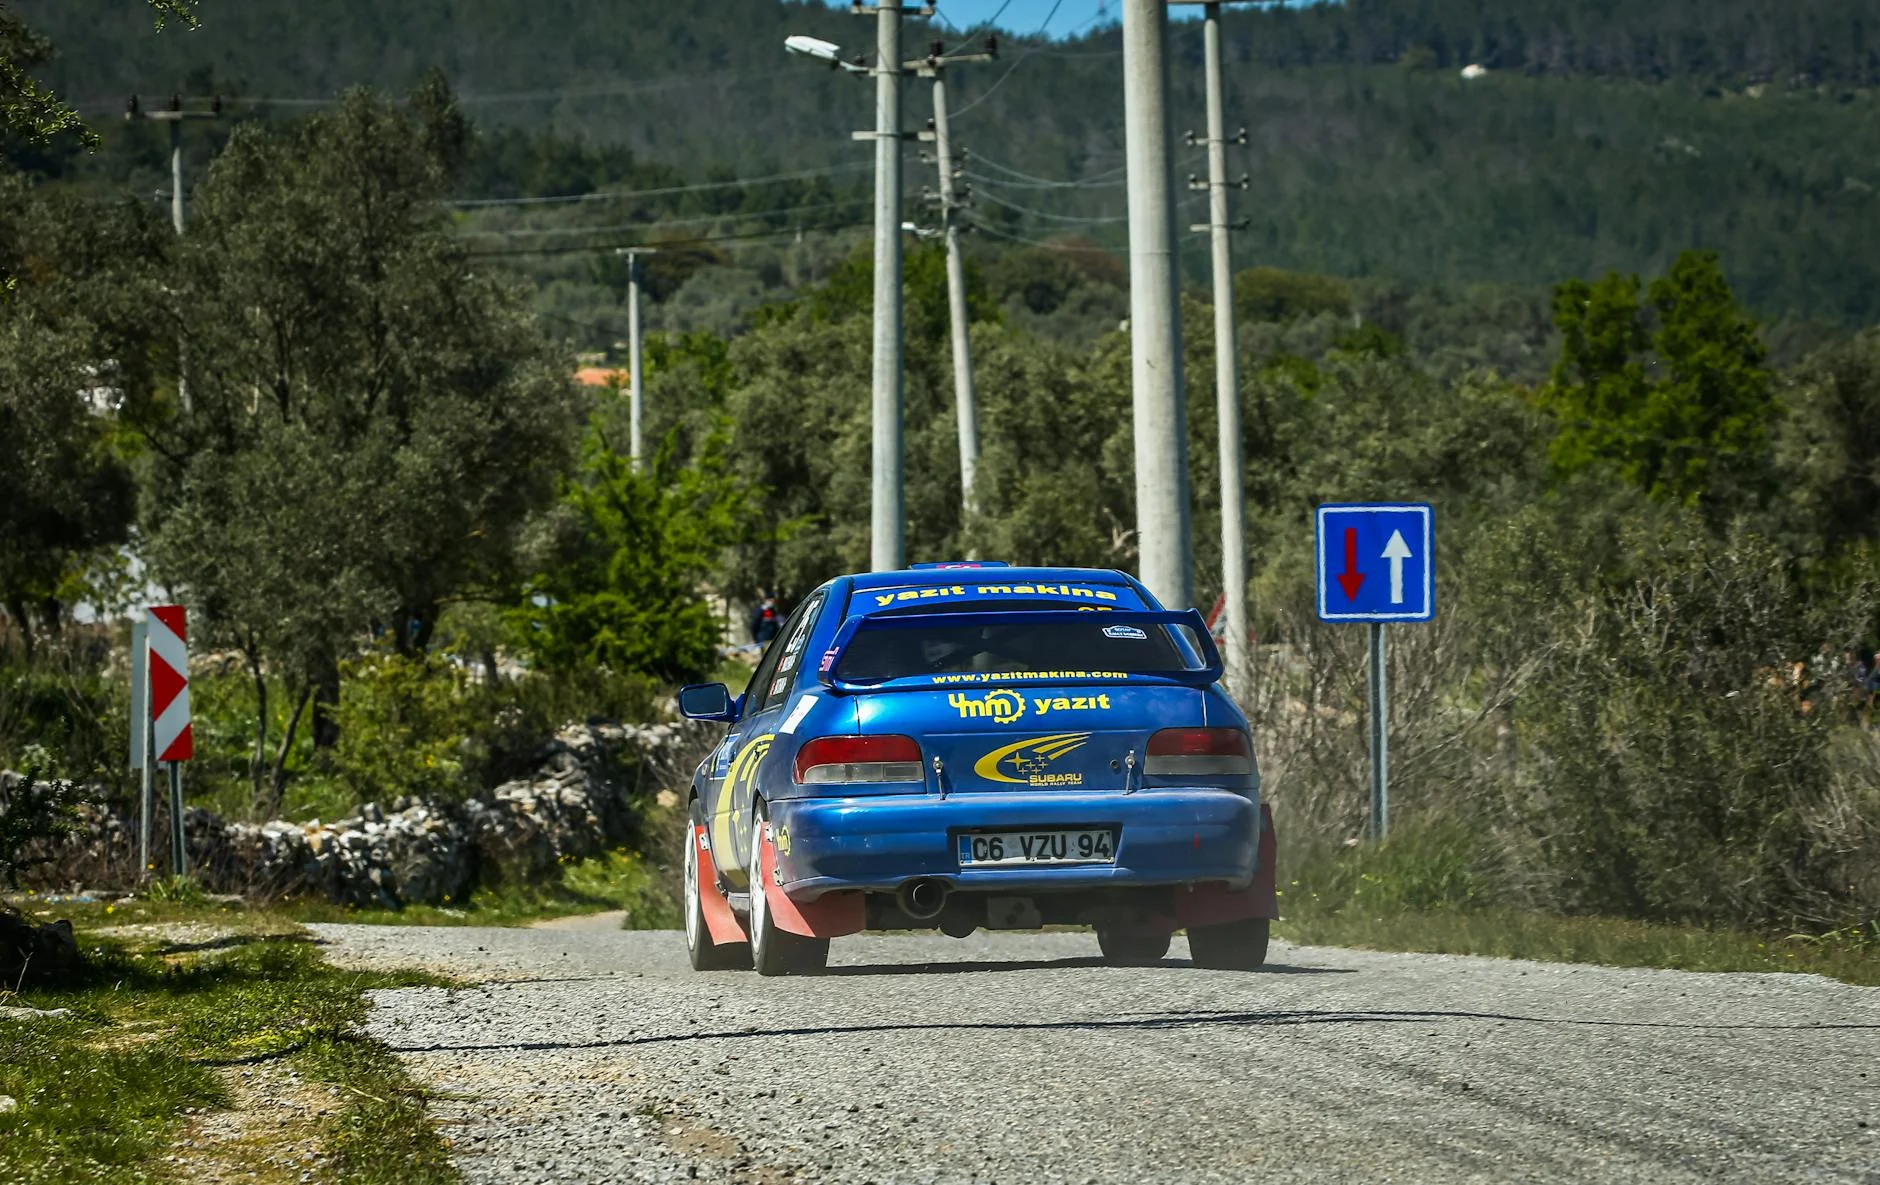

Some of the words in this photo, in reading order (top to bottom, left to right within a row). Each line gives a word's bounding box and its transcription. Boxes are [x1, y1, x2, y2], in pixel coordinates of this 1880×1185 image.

[932, 671, 1128, 684] www.yazitmakina.com
[1029, 773, 1082, 783] SUBARU
[1020, 834, 1067, 860] VZU
[1078, 833, 1111, 858] 94
